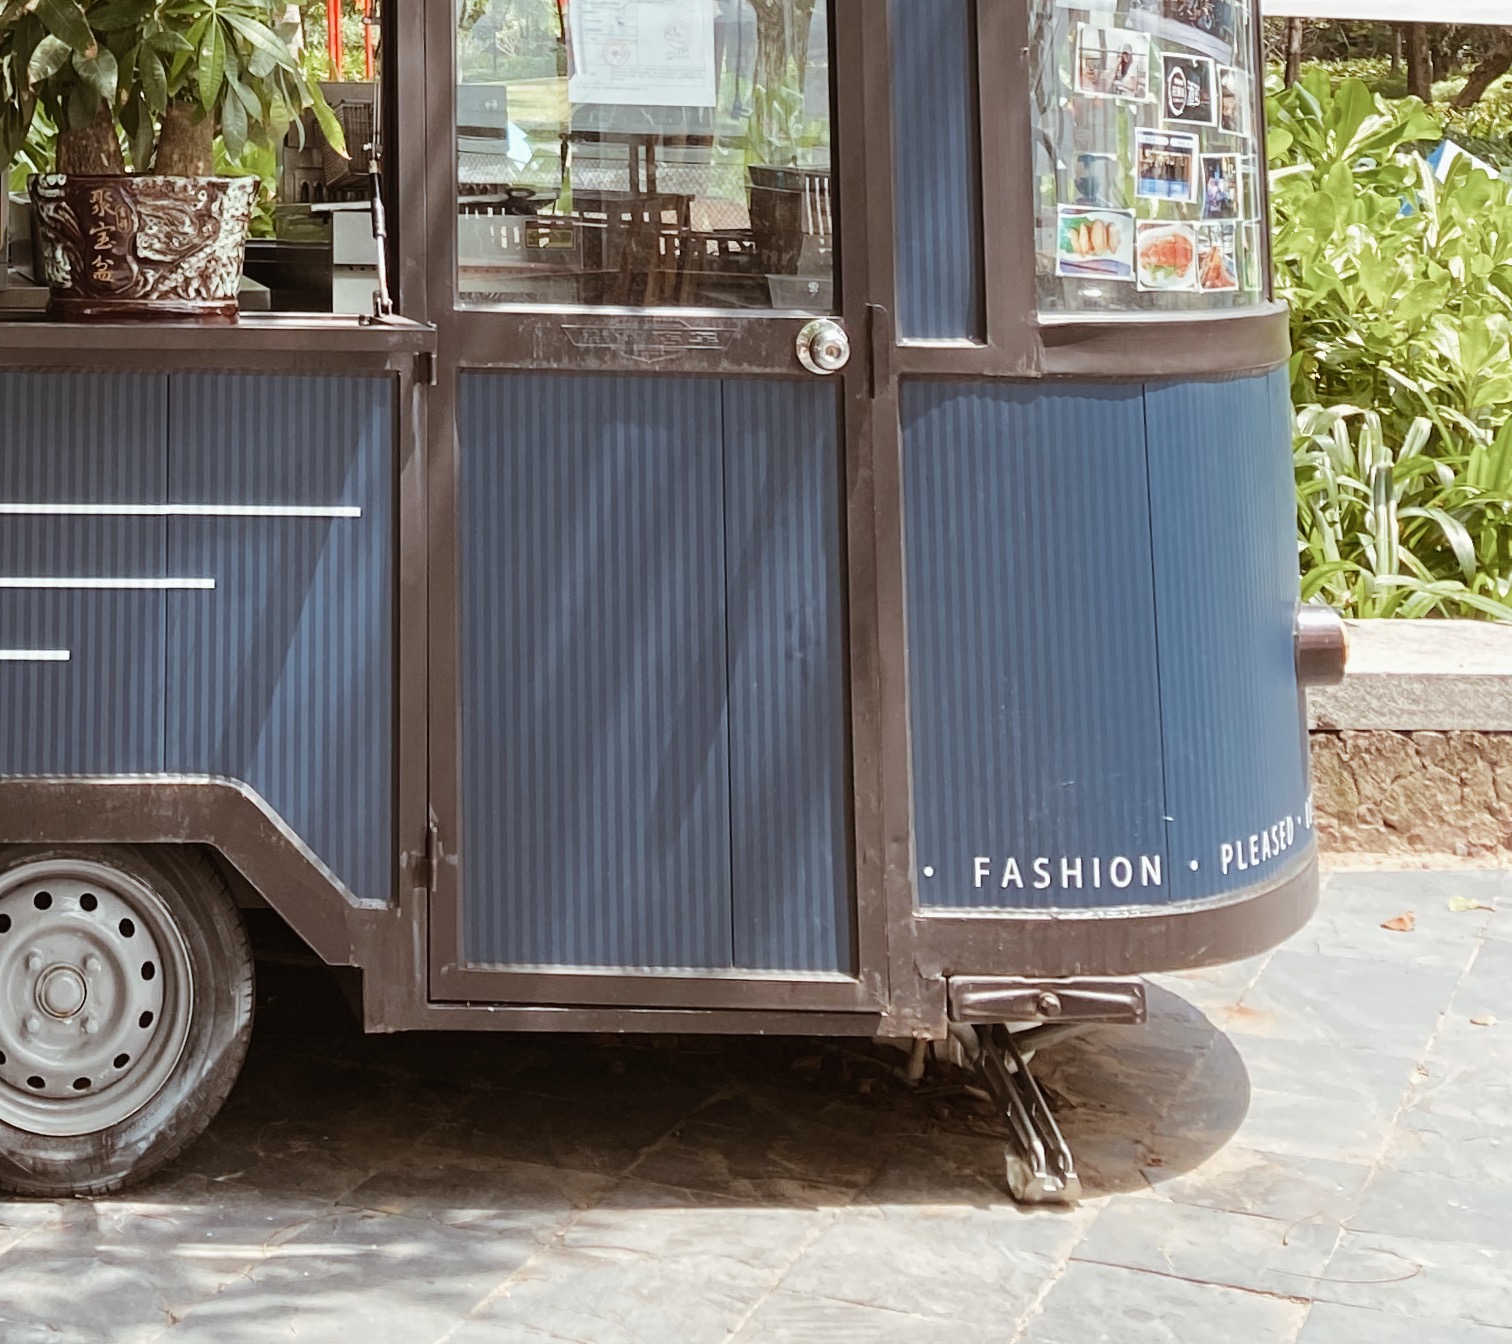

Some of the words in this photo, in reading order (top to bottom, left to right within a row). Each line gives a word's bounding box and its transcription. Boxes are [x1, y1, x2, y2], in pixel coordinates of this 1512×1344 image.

[90, 189, 116, 283] 聚宝盆
[974, 854, 1163, 889] FASHION
[1220, 816, 1295, 875] PLEASED
